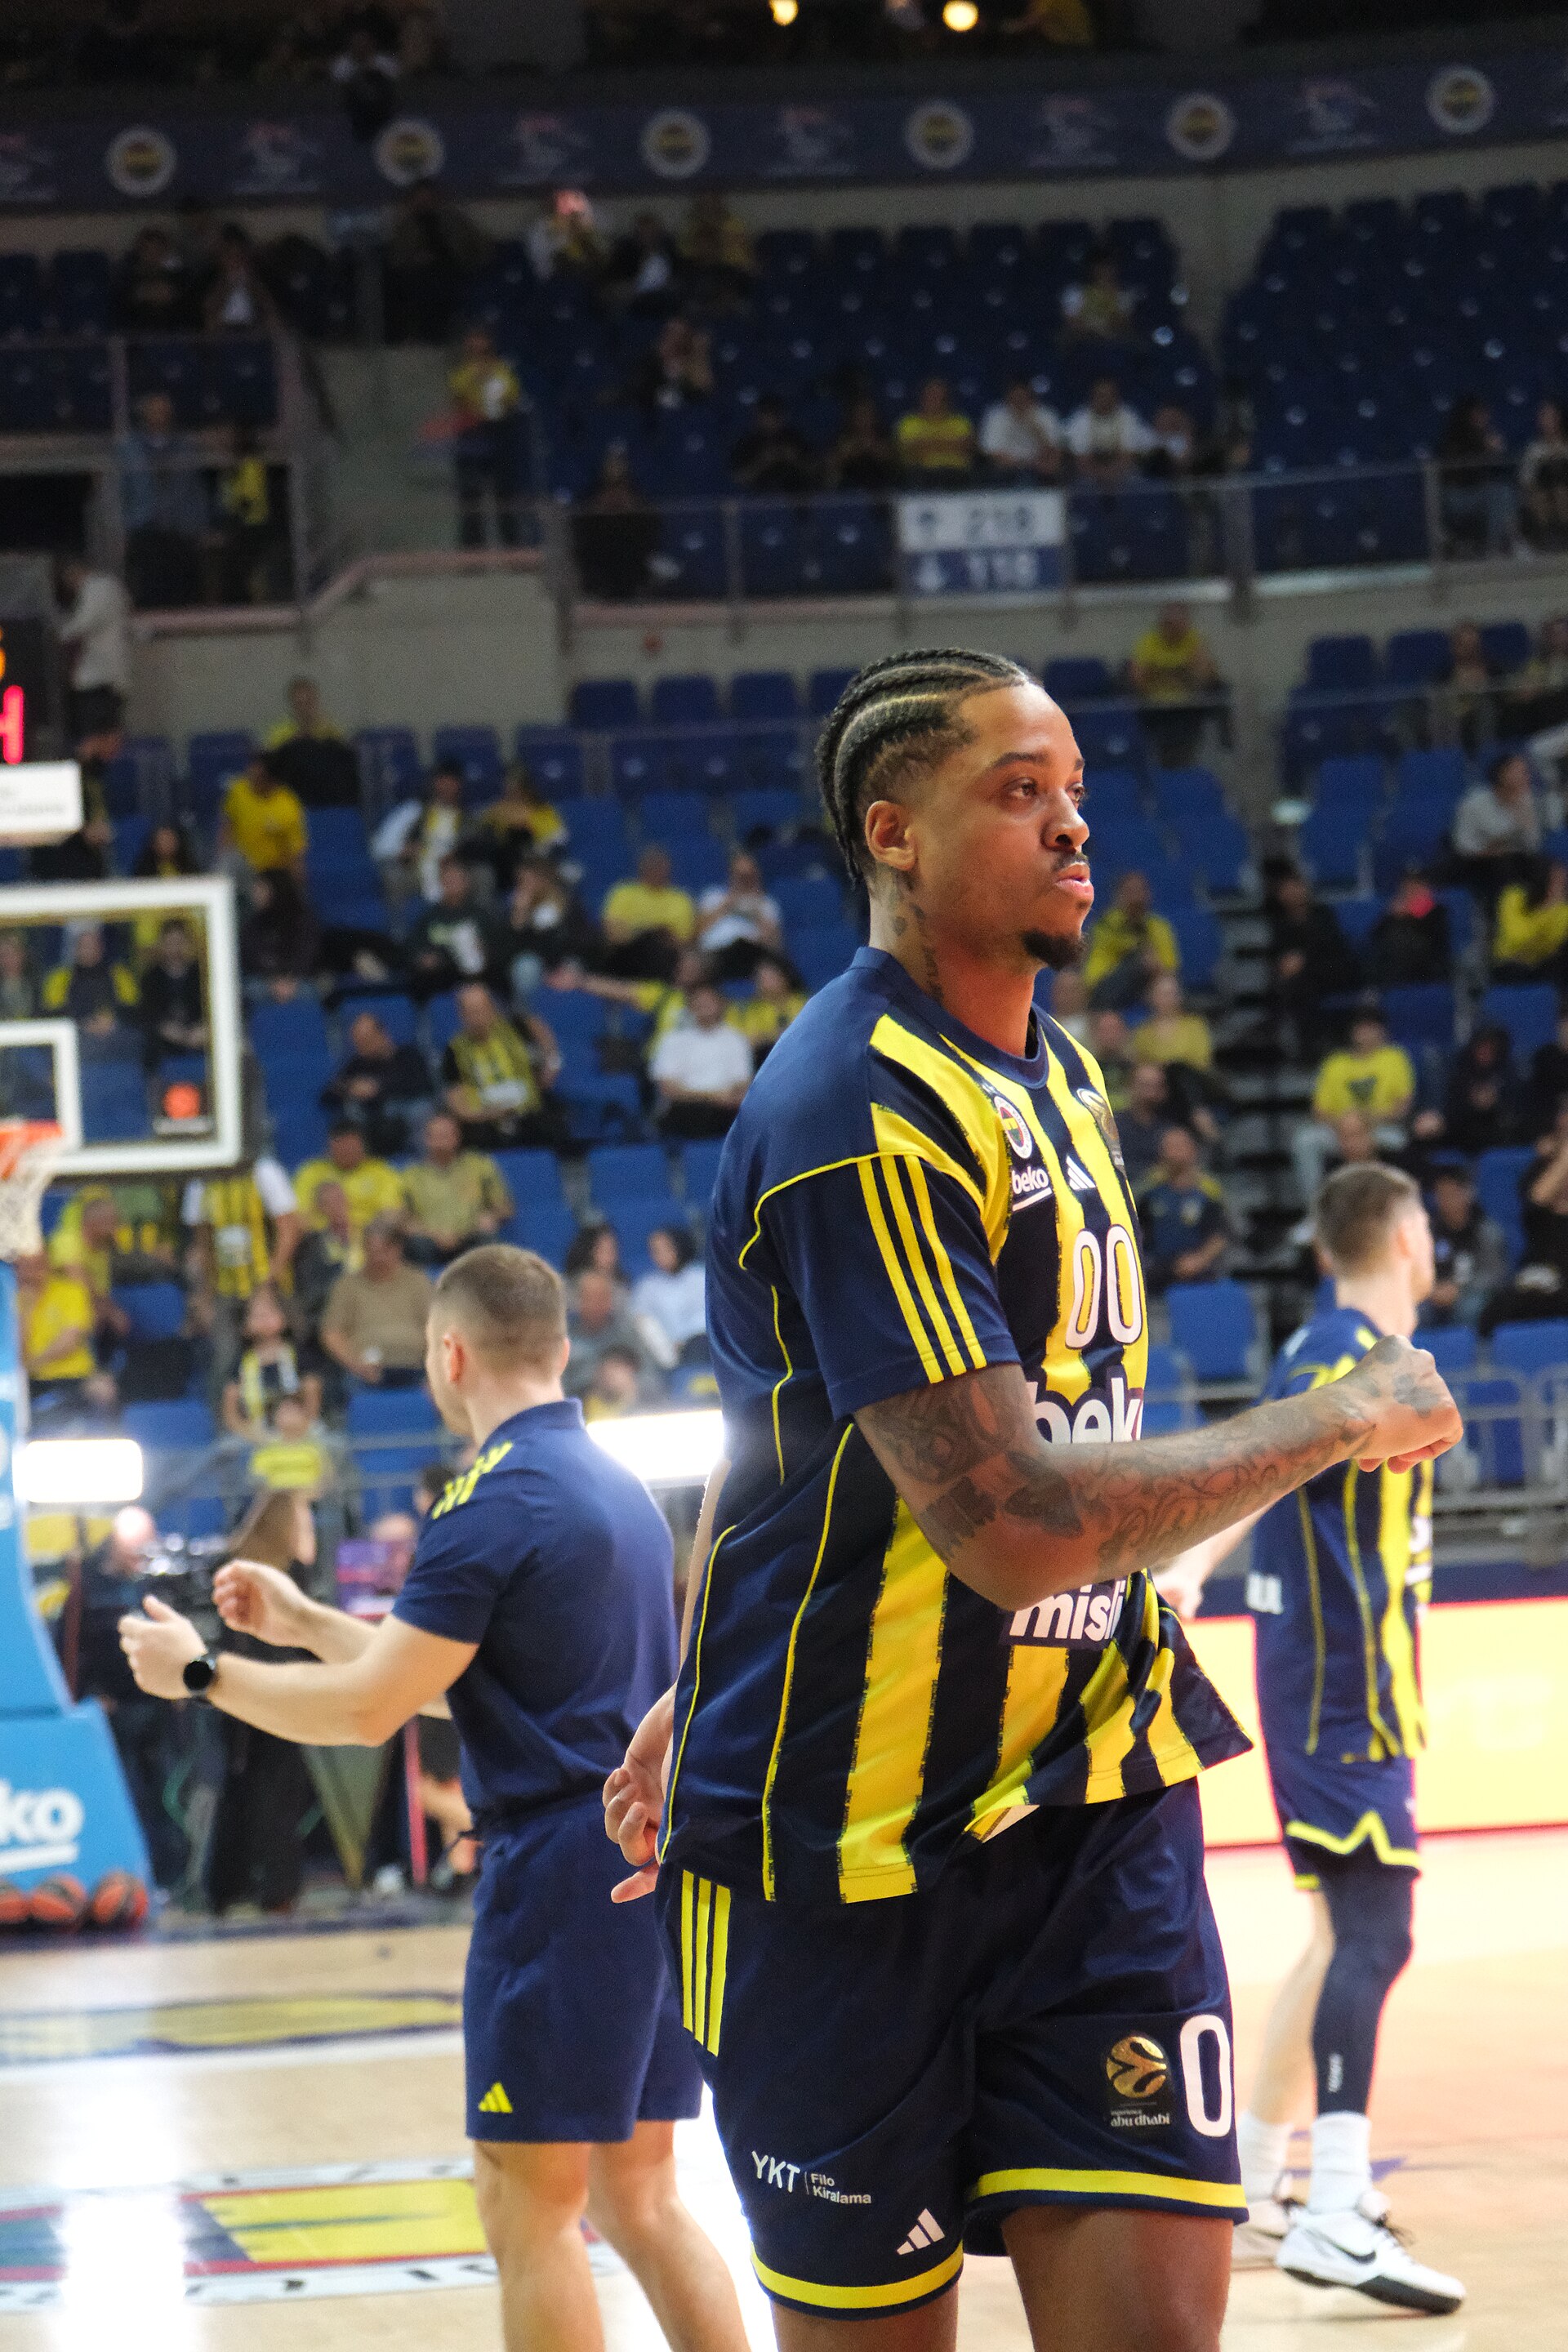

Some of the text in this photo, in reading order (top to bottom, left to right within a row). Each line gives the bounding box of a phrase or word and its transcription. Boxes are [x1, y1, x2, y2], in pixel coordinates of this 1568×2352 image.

[1012, 1166, 1049, 1194] beko
[1066, 1225, 1143, 1348] 00
[1026, 1377, 1143, 1443] bek
[1009, 1579, 1126, 1642] misli
[1180, 2014, 1232, 2137] 0
[1111, 2113, 1170, 2127] abu dhabi
[751, 2150, 801, 2193] YKT
[810, 2173, 835, 2187] Filo
[812, 2185, 872, 2204] Kiralama
